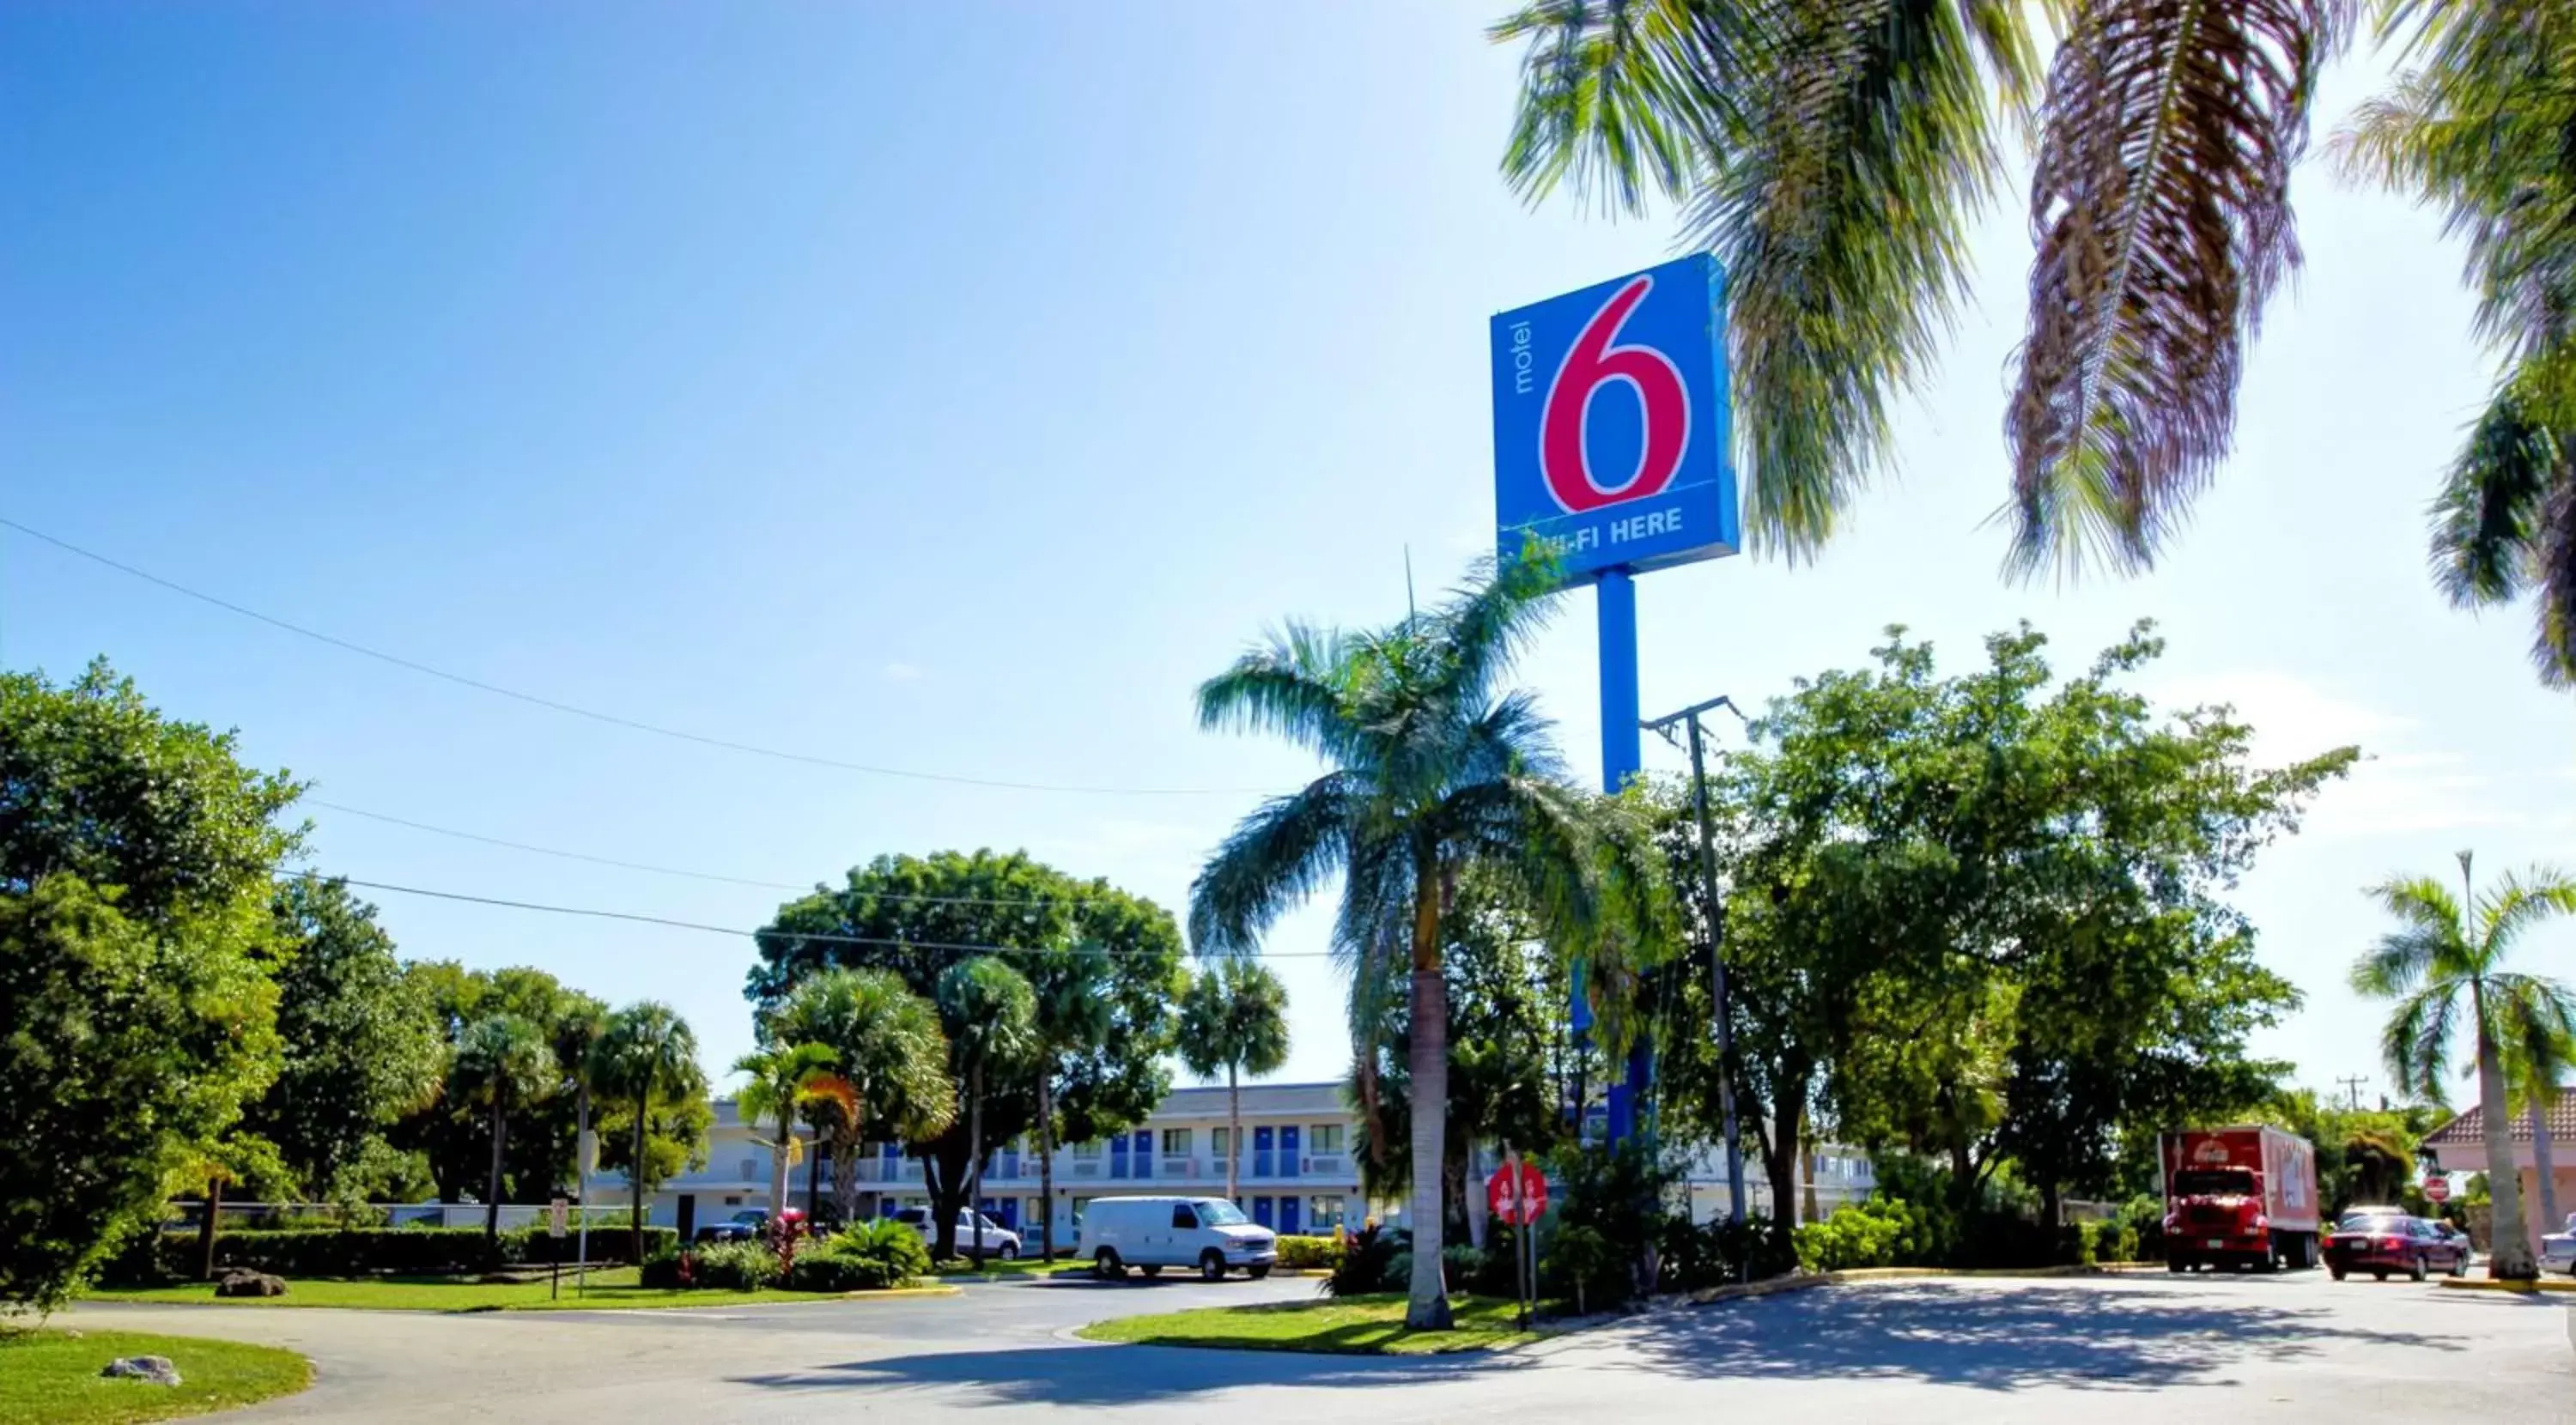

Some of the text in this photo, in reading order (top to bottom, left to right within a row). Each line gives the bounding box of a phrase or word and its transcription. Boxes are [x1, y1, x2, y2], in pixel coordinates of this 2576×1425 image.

[1509, 320, 1534, 394] motel
[1538, 274, 1692, 515] 6
[1609, 507, 1683, 544] HERE
